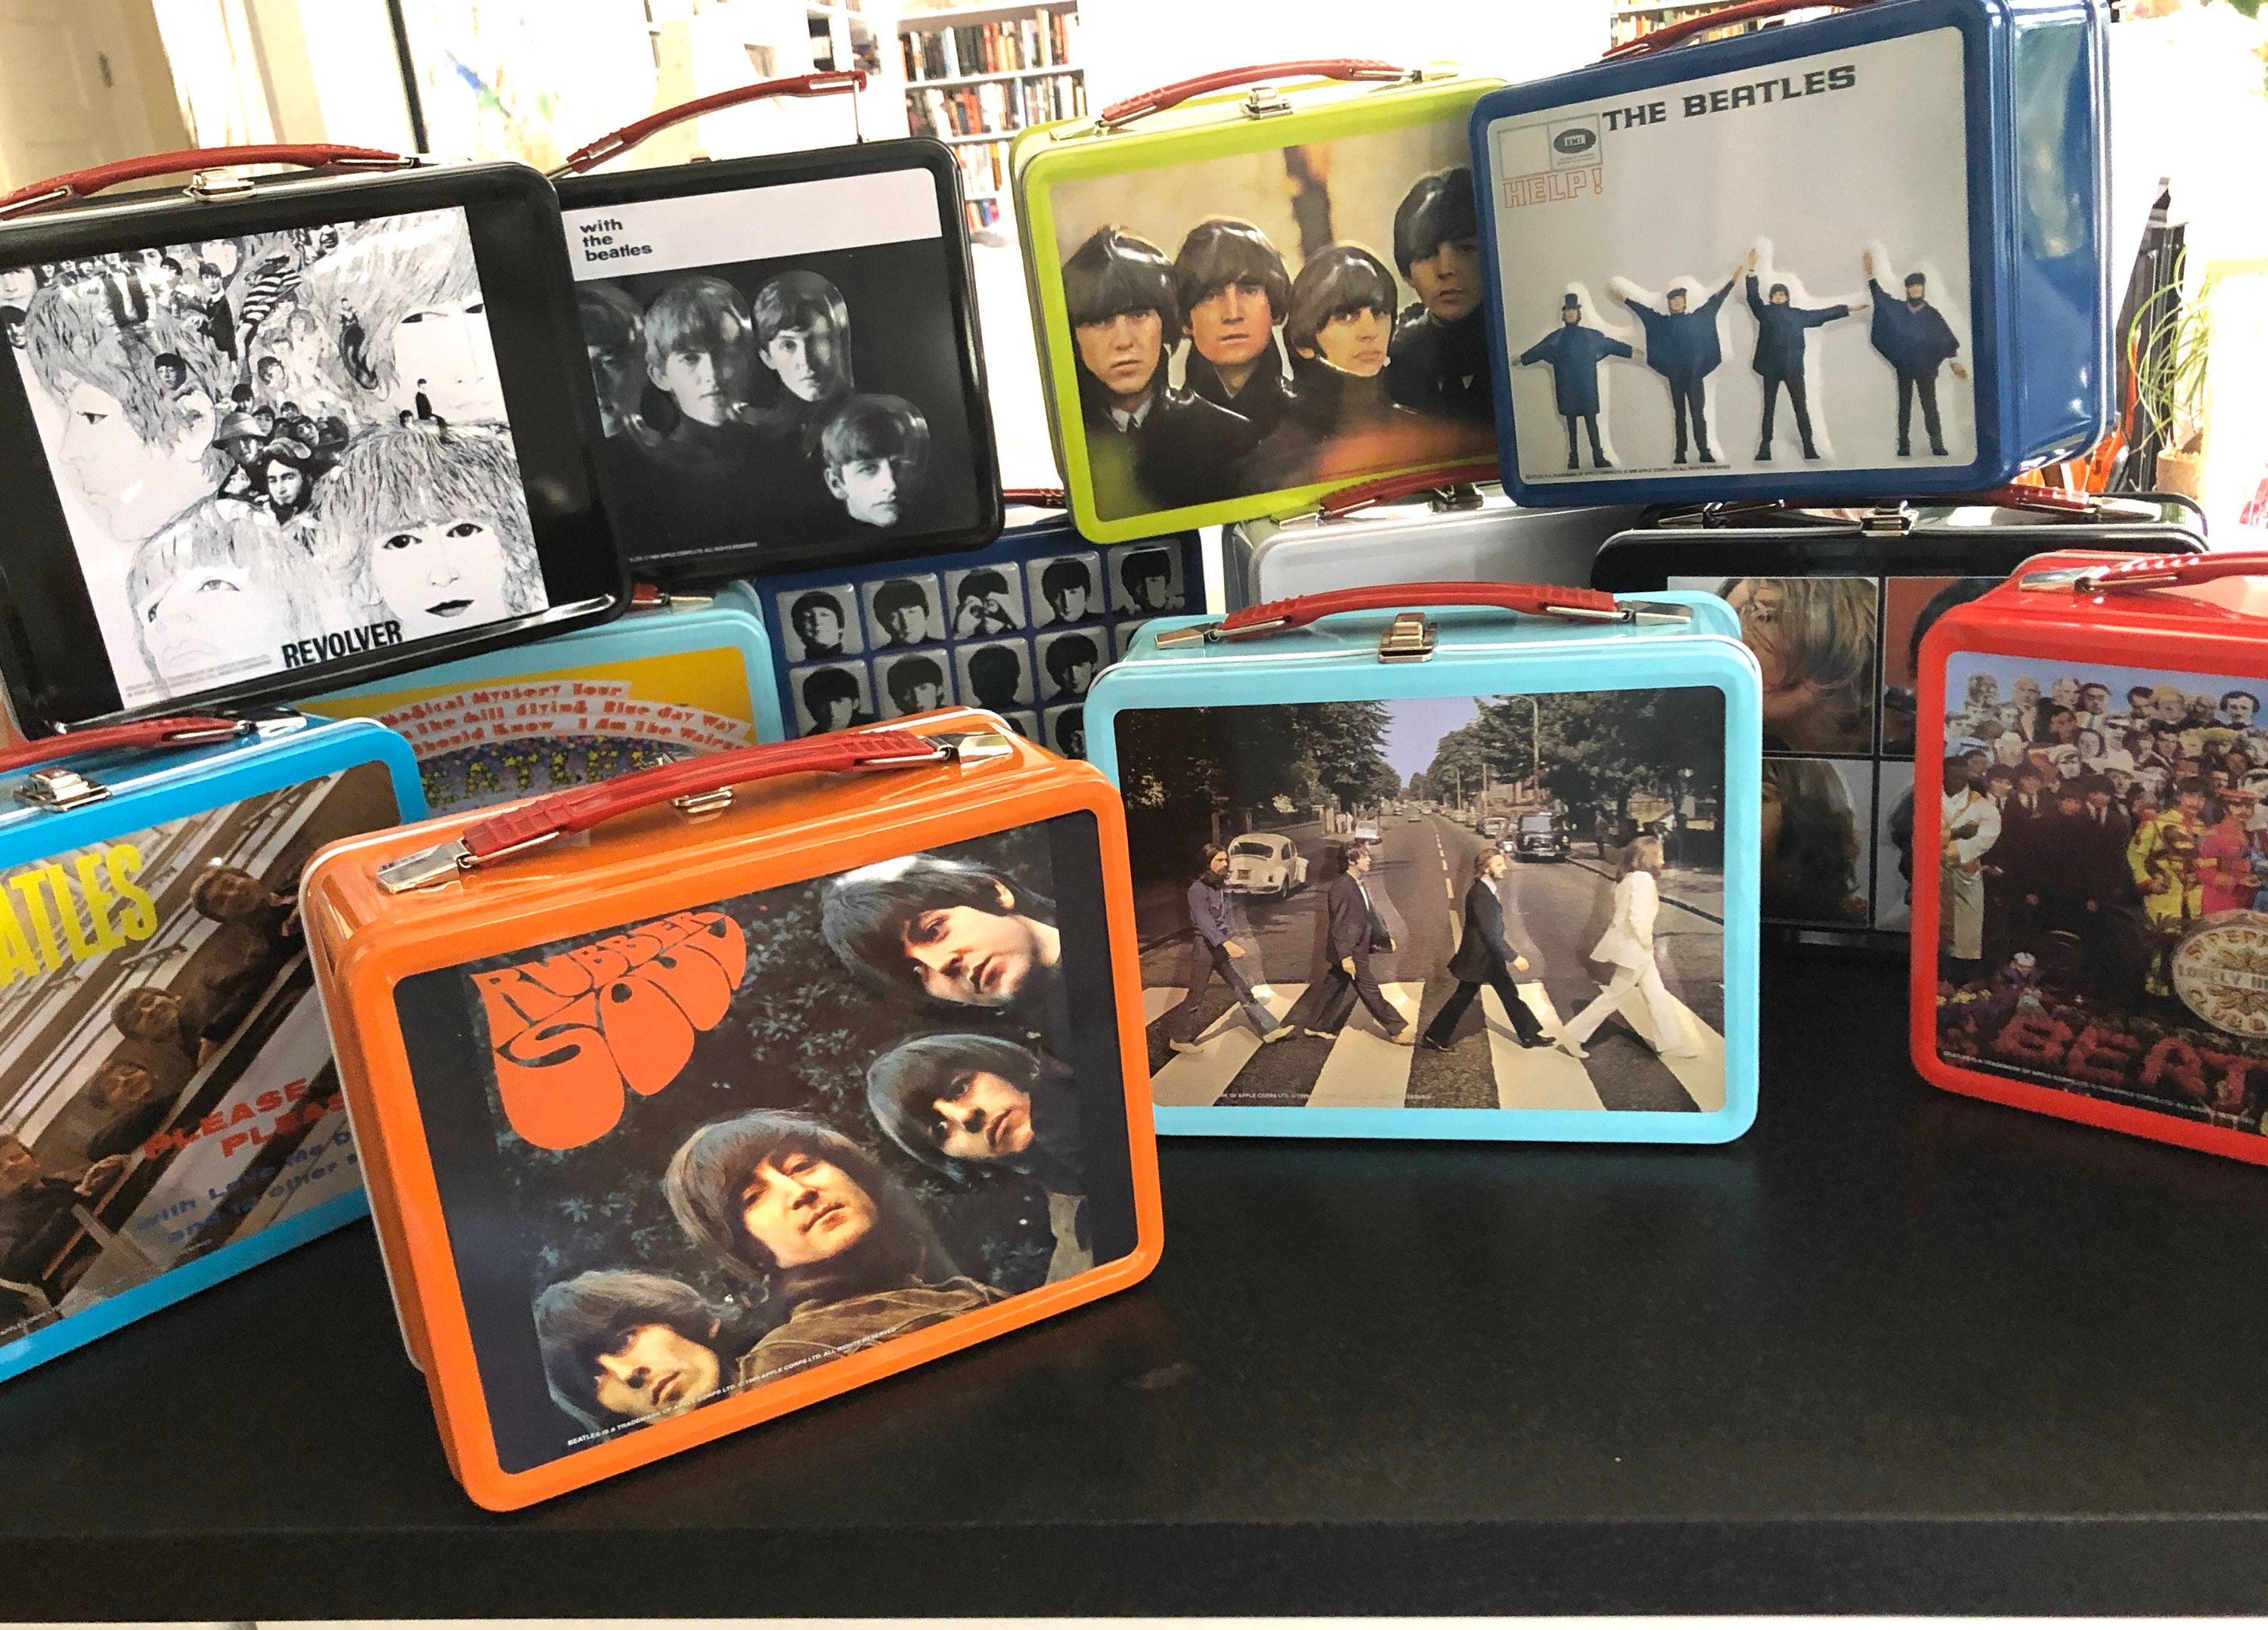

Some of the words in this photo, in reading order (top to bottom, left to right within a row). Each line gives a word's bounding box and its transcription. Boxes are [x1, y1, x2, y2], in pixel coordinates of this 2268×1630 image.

[1602, 101, 1666, 132] THE
[1684, 64, 1856, 118] BEATLES
[1566, 137, 1582, 145] EMI
[1503, 167, 1603, 208] HELP!
[579, 218, 623, 233] with
[582, 235, 613, 247] the
[584, 244, 653, 262] beatles
[281, 619, 403, 668] REVOLVER
[469, 911, 709, 1049] RUBBER
[493, 911, 748, 1151] SOUL
[144, 1077, 307, 1159] PLEASE
[567, 1432, 602, 1446] BEATLES
[602, 1427, 609, 1436] IS
[617, 1410, 662, 1430] TRADEMARK
[662, 1406, 672, 1415] OF
[761, 1367, 783, 1380] APPLE
[784, 1358, 807, 1371] CORPS
[823, 1348, 836, 1357] ALL
[836, 1339, 862, 1353] RIGHTS
[862, 1326, 897, 1343] RESERVED
